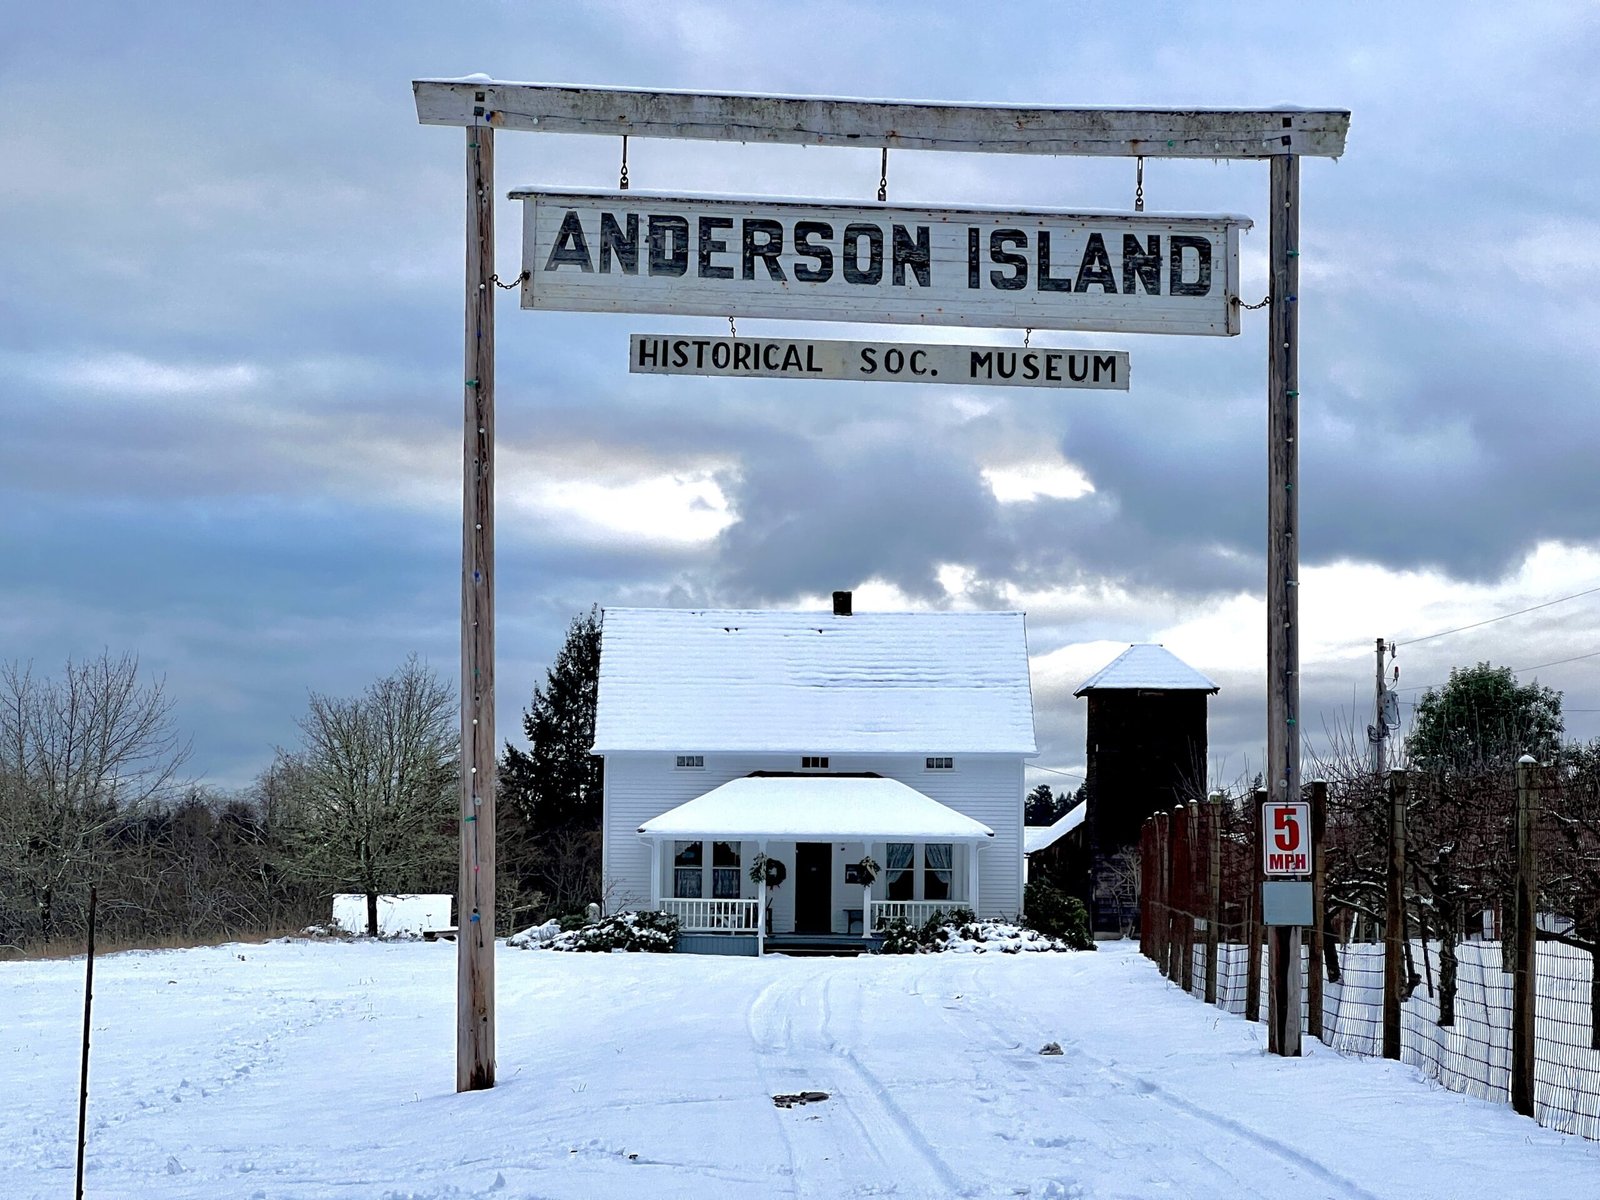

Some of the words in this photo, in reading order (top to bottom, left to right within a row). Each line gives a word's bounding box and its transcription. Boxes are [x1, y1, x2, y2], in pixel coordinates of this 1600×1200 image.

[544, 210, 931, 287] ANDERSON
[968, 227, 1212, 297] ISLAND
[638, 339, 823, 373] HISTORICAL
[860, 347, 938, 377] SOC.
[970, 351, 1116, 382] MUSEUM
[1274, 808, 1300, 851] 5
[1269, 854, 1306, 870] MPH
